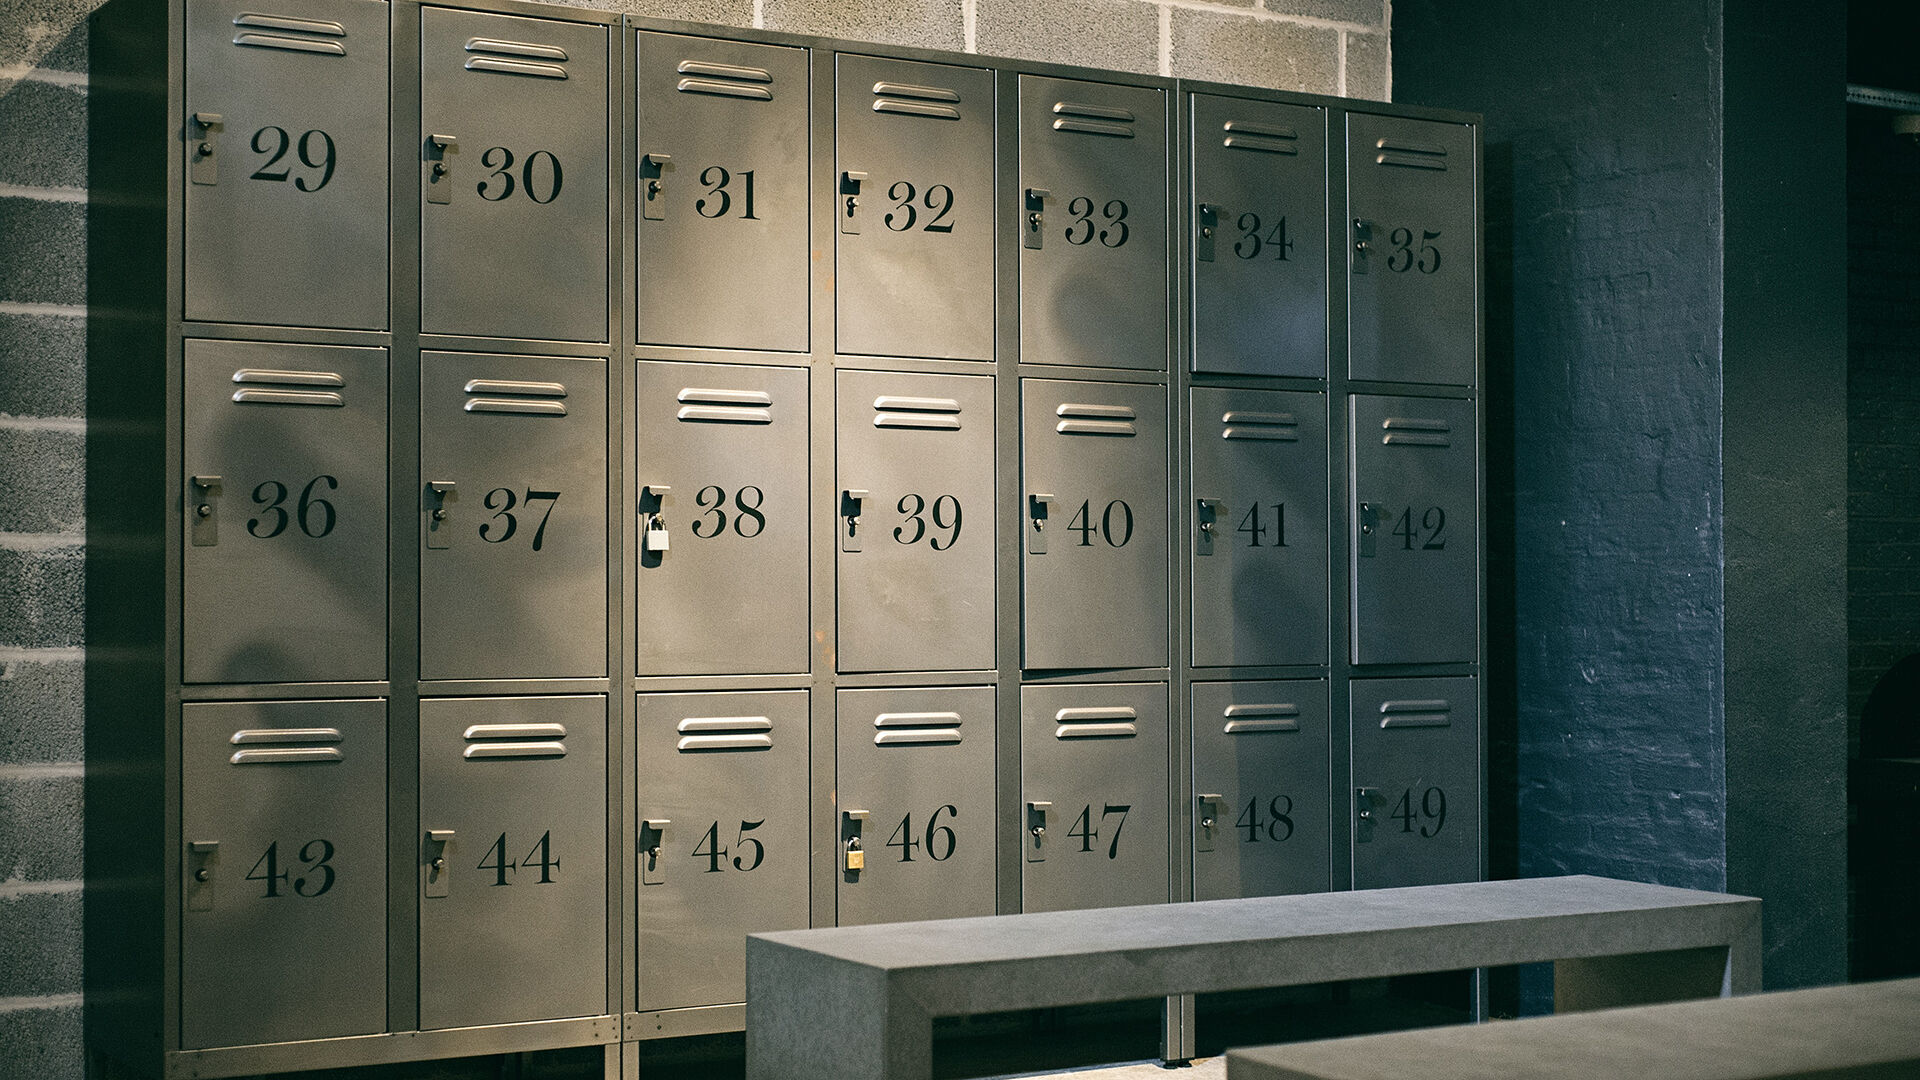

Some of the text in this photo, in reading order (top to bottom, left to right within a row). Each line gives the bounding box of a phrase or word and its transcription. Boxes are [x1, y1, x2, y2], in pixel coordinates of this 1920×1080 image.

[250, 127, 336, 192] 29
[477, 147, 563, 204] 30
[696, 166, 760, 219] 31
[885, 182, 954, 233] 32
[1065, 197, 1129, 248] 33
[1234, 213, 1293, 261] 34
[1387, 228, 1441, 274] 35
[247, 475, 338, 538] 36
[479, 486, 560, 551] 37
[692, 486, 765, 538] 38
[893, 494, 962, 551] 39
[1067, 499, 1133, 547] 40
[1238, 502, 1289, 547] 41
[1392, 506, 1446, 551] 42
[886, 805, 957, 862] 46
[1067, 803, 1131, 859] 47
[1236, 795, 1294, 842] 48
[1389, 787, 1446, 839] 49
[246, 839, 335, 898] 43
[477, 830, 560, 886] 44
[692, 818, 764, 873] 45
